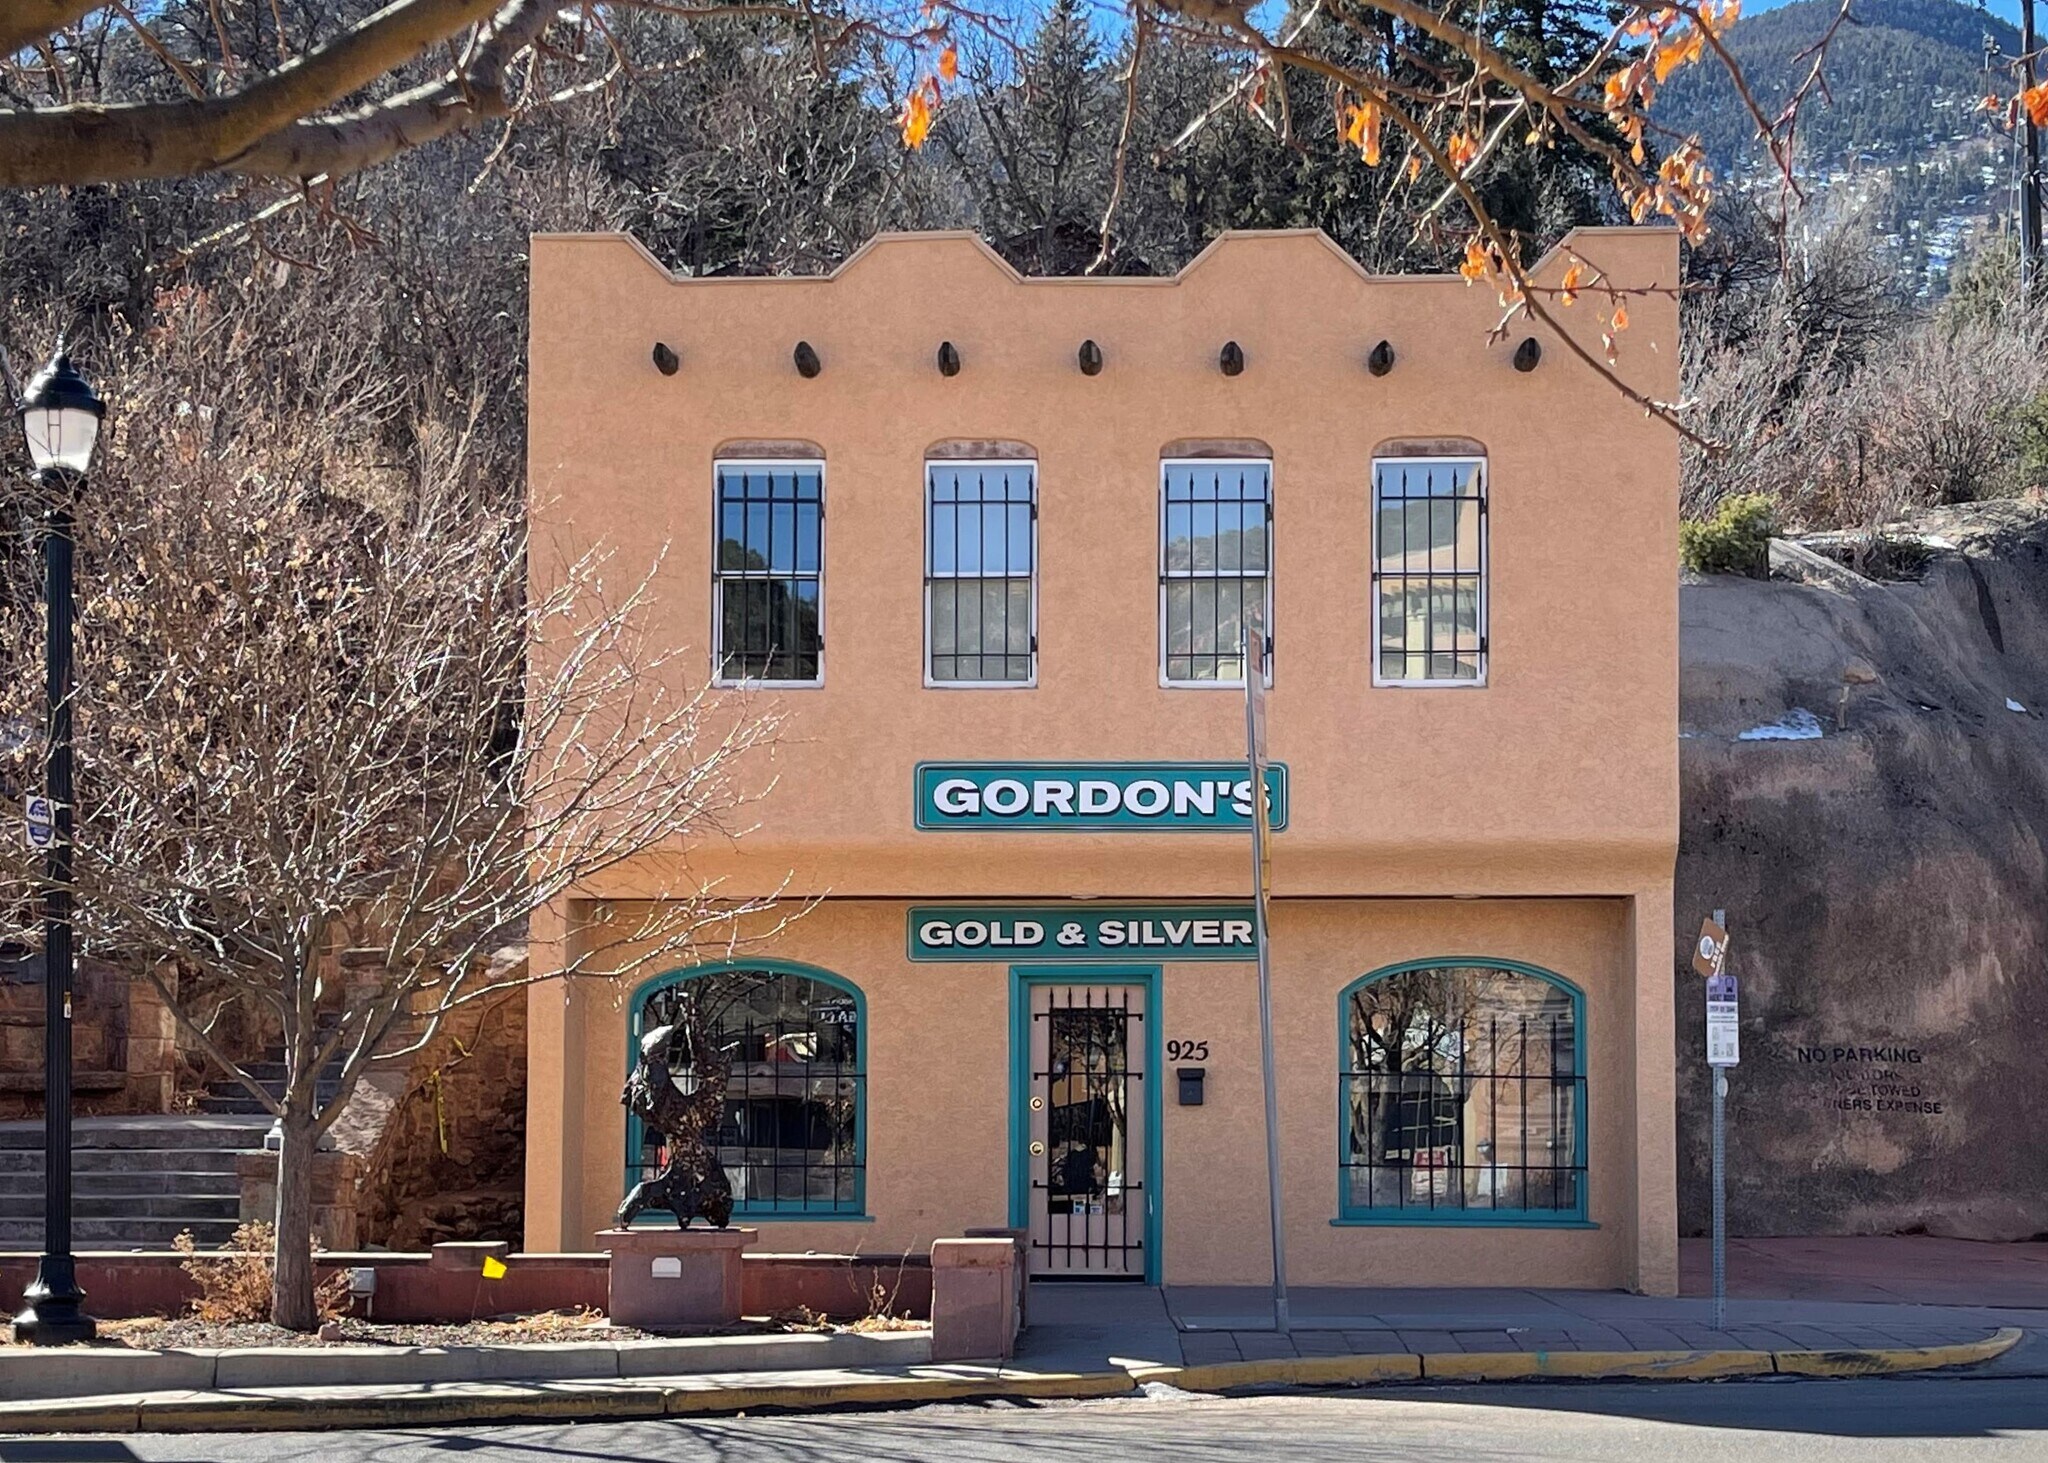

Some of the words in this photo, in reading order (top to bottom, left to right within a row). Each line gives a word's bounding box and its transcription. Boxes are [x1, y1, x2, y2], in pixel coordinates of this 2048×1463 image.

[933, 779, 1271, 815] GORDON'S
[919, 921, 1044, 946] GOLD
[1056, 921, 1088, 946] &
[1098, 920, 1254, 945] SILVER
[1167, 1040, 1209, 1061] 925
[1797, 1047, 1826, 1063] NO
[1833, 1047, 1922, 1063] PARKING
[1871, 1084, 1921, 1097] TOWED
[1877, 1099, 1944, 1114] EXPENSE
